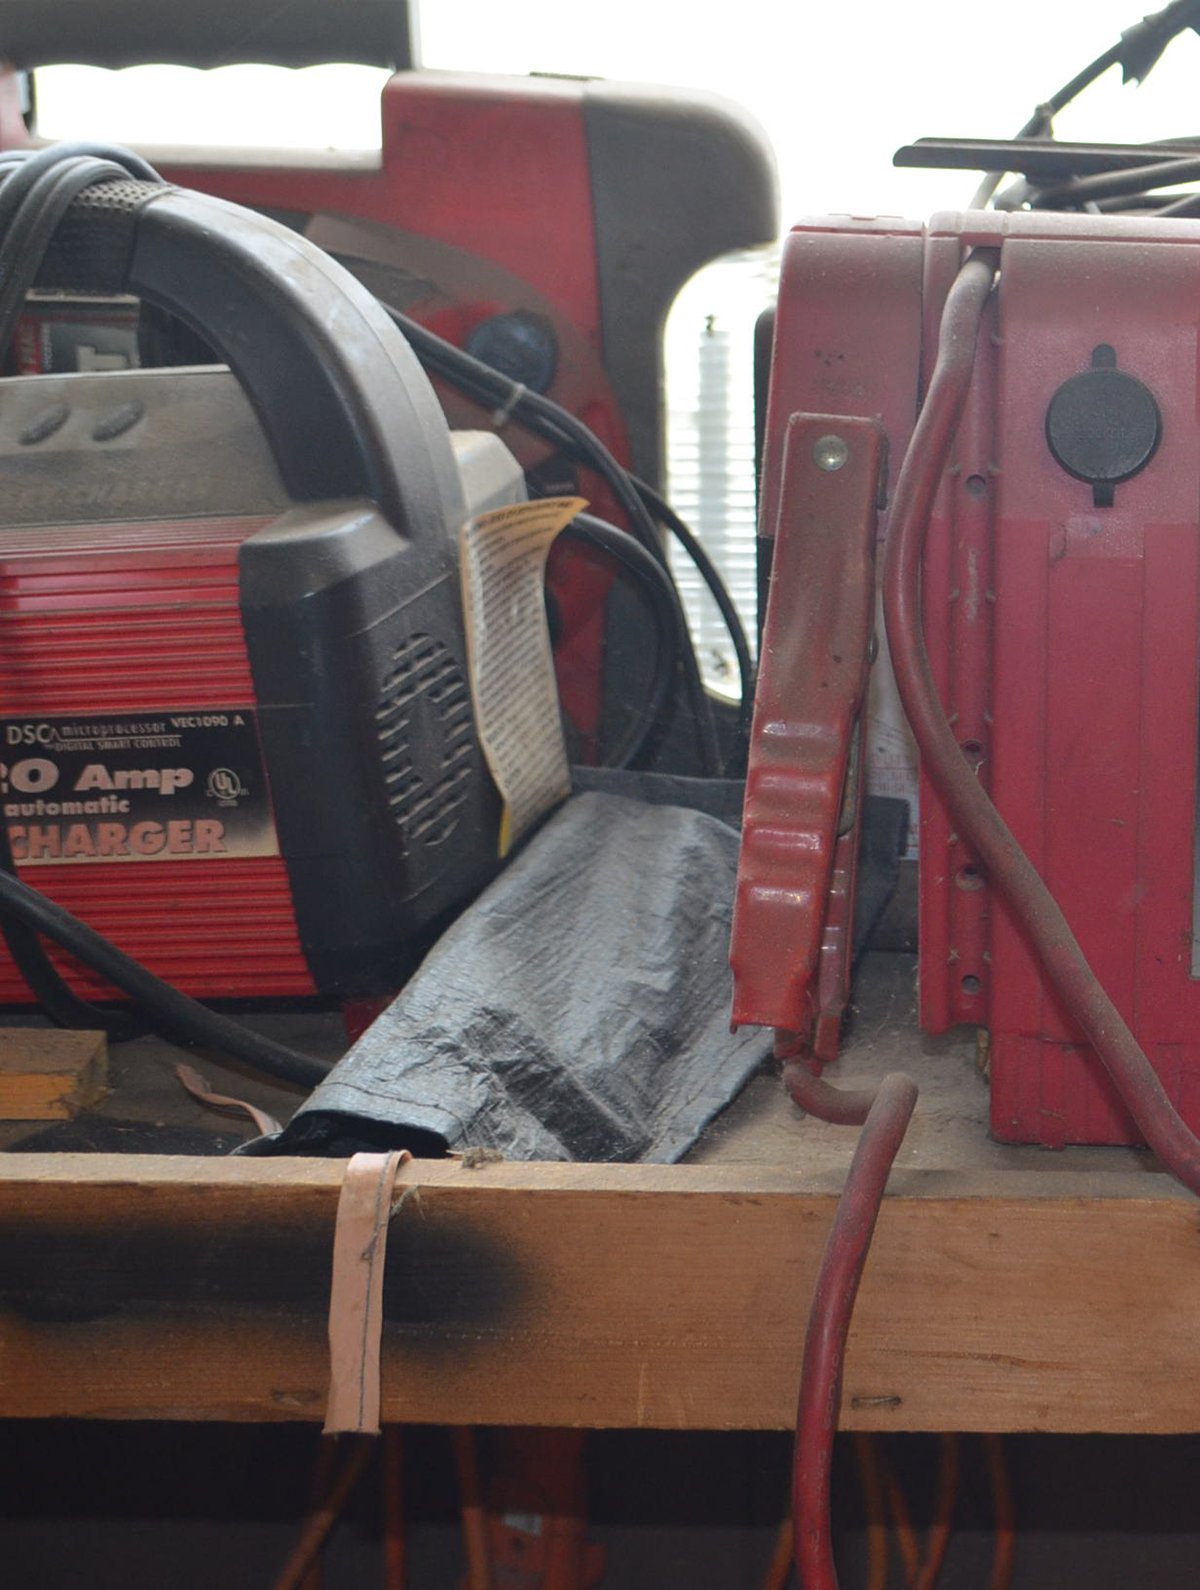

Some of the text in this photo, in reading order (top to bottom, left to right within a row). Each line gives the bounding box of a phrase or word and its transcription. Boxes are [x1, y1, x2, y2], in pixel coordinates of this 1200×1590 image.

[6, 721, 167, 746] DSC microprocessor
[55, 737, 182, 752] DIGITAL SMART CONTROL
[0, 757, 195, 796] 0 Amp
[3, 794, 131, 818] automatic
[8, 818, 228, 860] CHARGER
